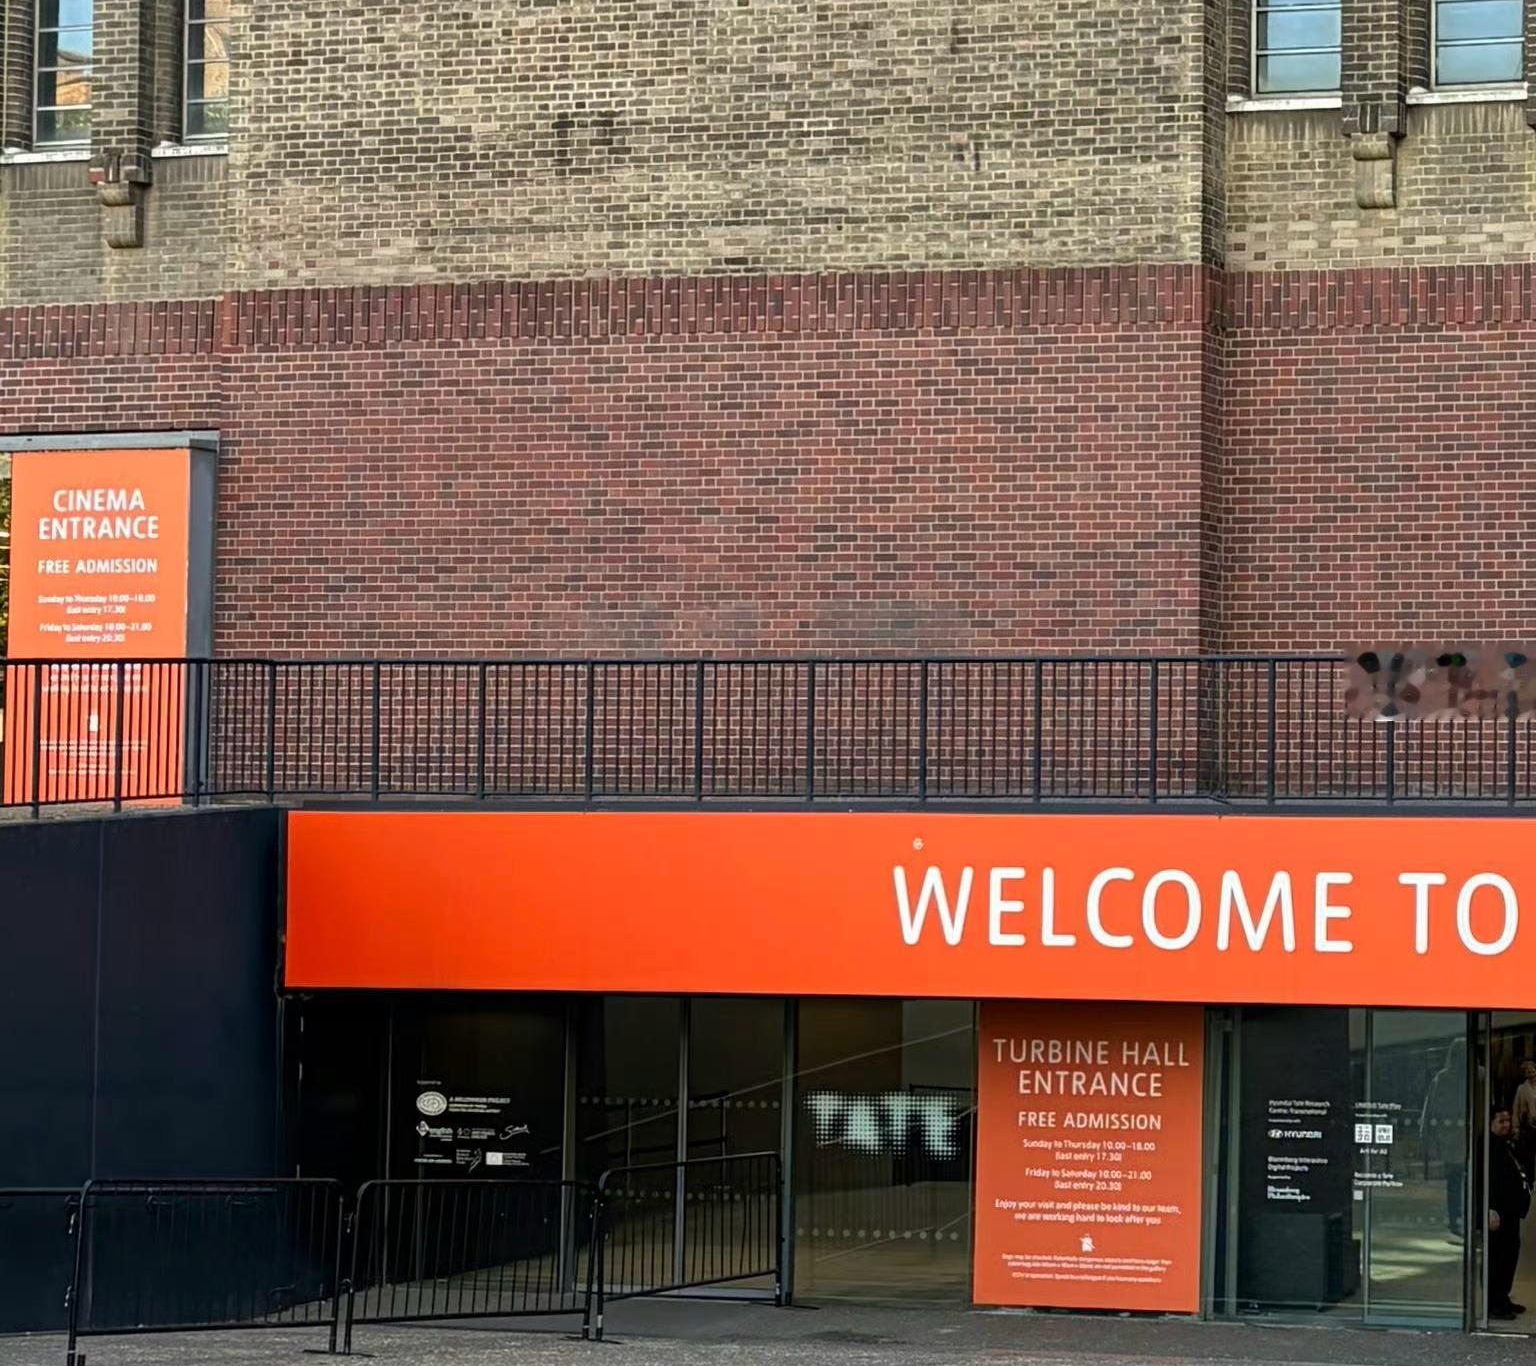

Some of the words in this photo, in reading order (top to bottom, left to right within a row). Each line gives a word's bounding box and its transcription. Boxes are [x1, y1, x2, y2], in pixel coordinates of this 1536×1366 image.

[53, 489, 145, 512] CINEMA
[38, 516, 159, 540] ENTRANCE
[38, 559, 69, 574] FREE
[75, 558, 157, 573] ADMISSION
[892, 866, 1353, 952] WELCOME
[1398, 872, 1519, 955] TO
[993, 1038, 1109, 1065] TURBINE
[1122, 1041, 1190, 1067] HALL
[1019, 1070, 1162, 1097] ENTRANCE
[1018, 1111, 1056, 1128] FREE
[1063, 1113, 1161, 1130] ADMISSION
[1023, 1139, 1052, 1150] Sunday
[1054, 1140, 1062, 1148] to
[1063, 1140, 1101, 1150] Thursday
[1073, 1153, 1095, 1162] entry
[1025, 1168, 1050, 1179] Friday
[1051, 1169, 1060, 1177] to
[1061, 1168, 1097, 1179] Saturday
